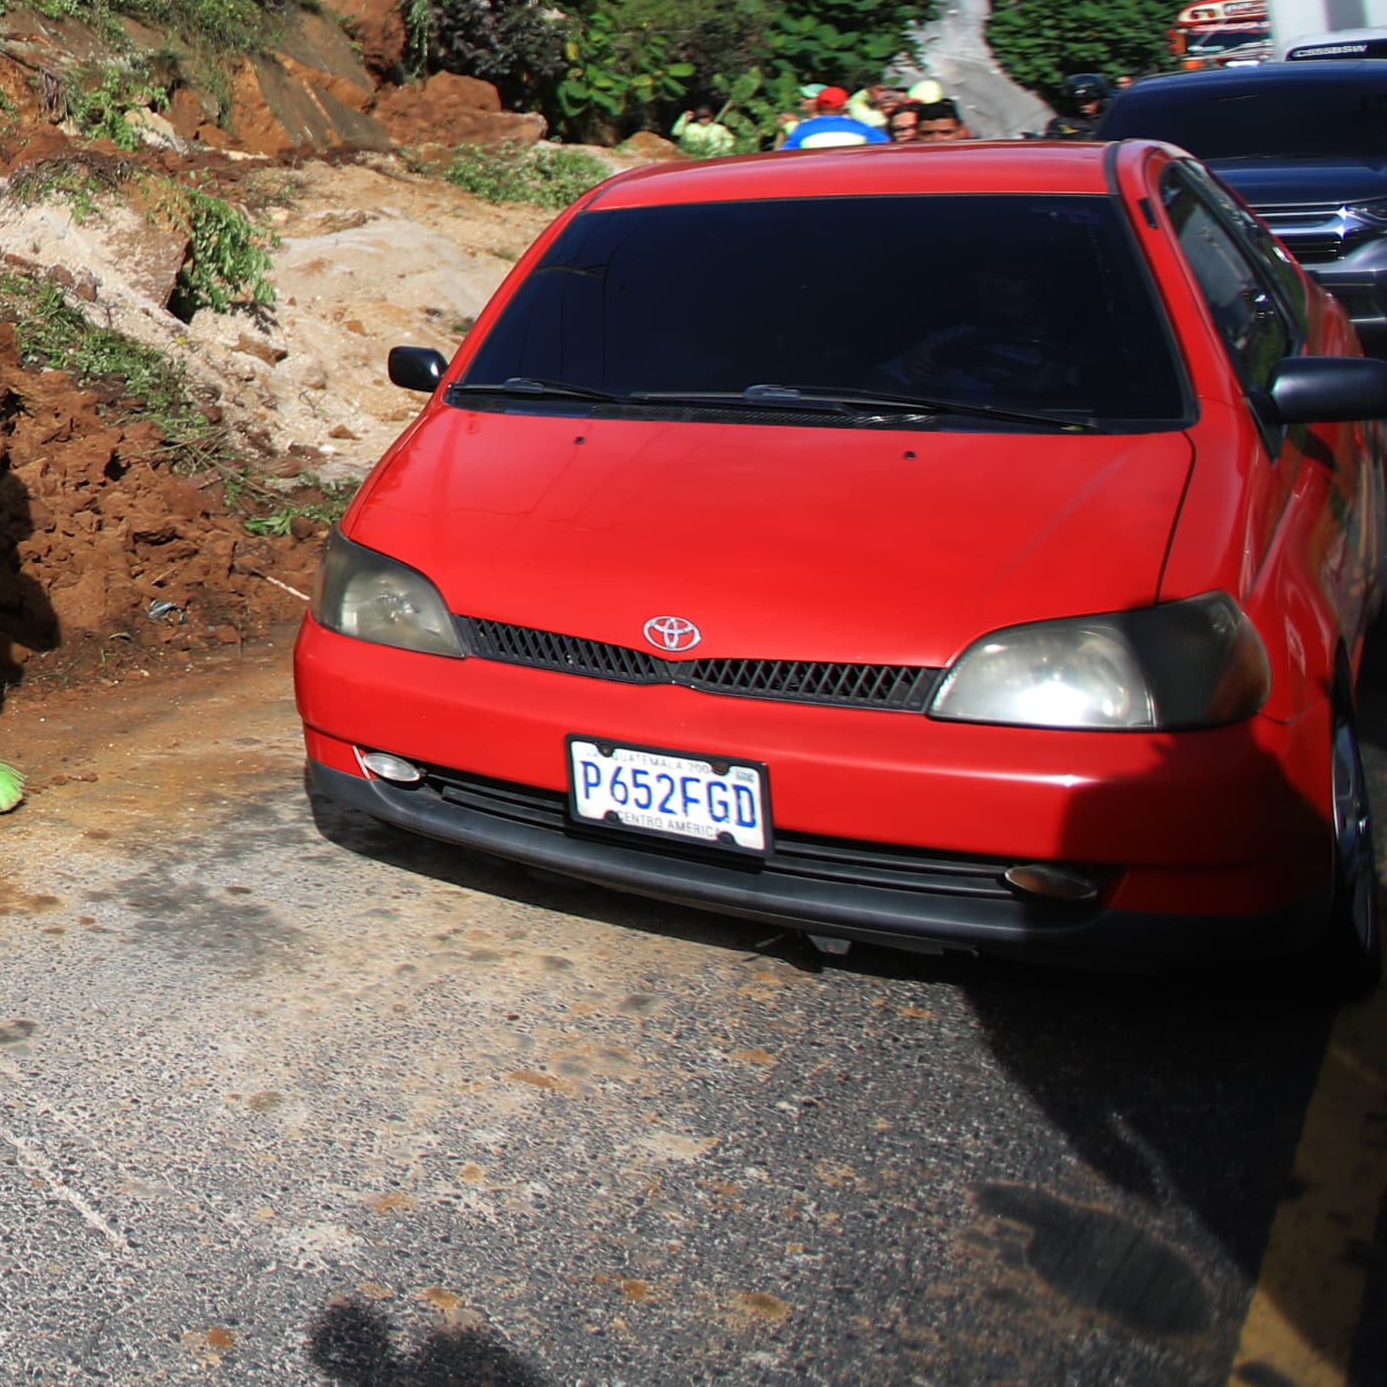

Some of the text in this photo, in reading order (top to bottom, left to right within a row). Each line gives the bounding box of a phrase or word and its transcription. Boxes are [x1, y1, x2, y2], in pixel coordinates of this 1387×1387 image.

[614, 752, 713, 775] GUATEMALA 200
[581, 760, 757, 829] P652FGD
